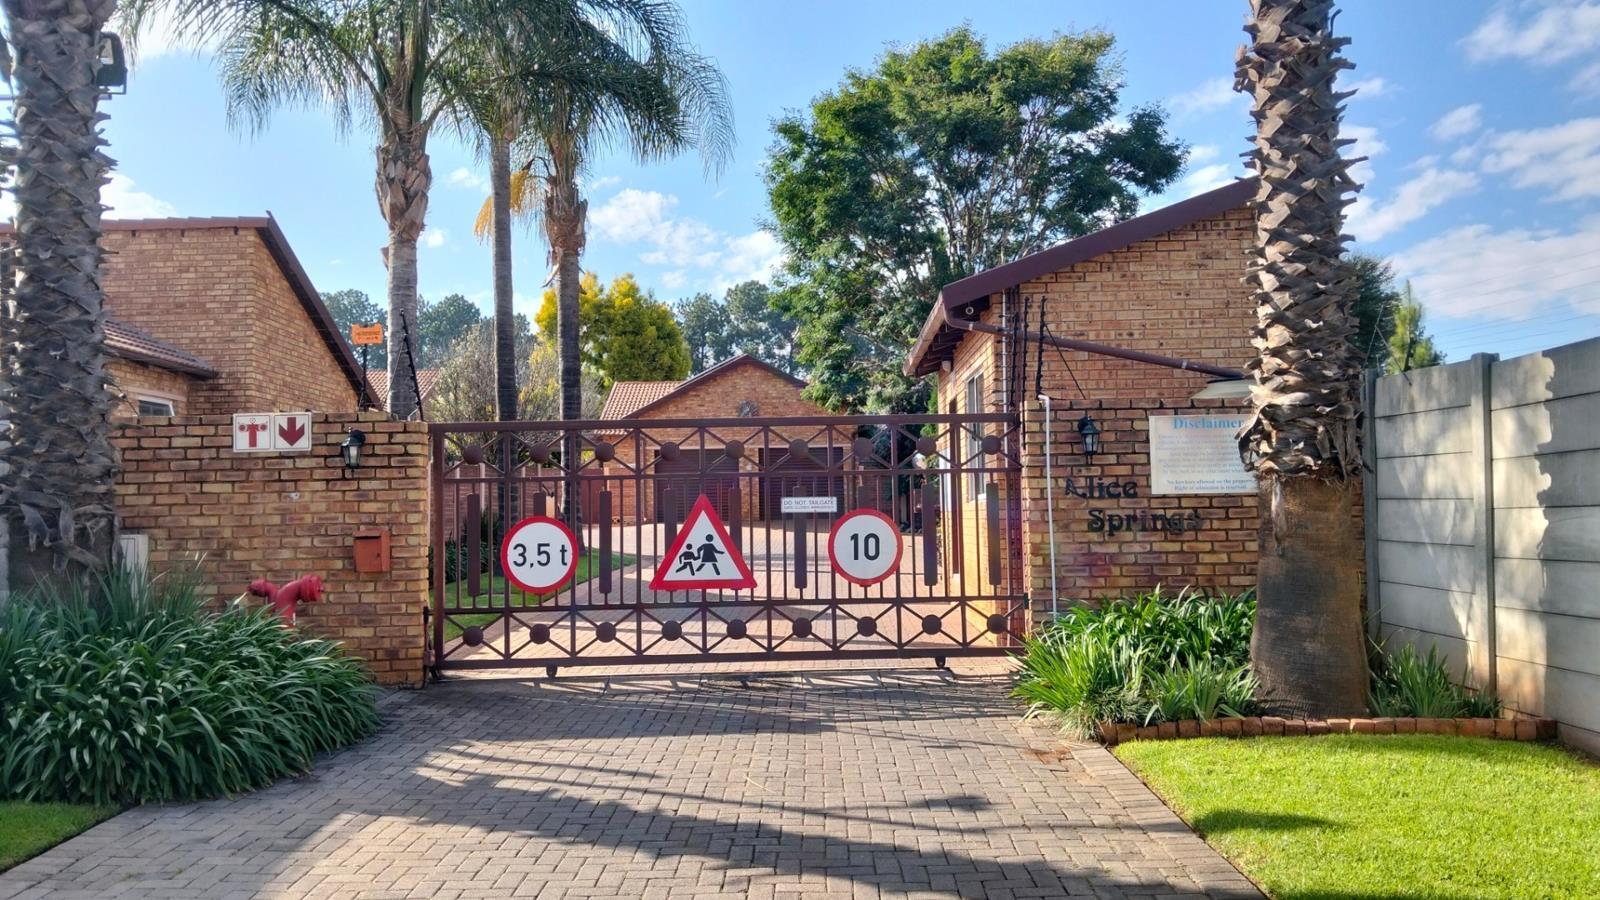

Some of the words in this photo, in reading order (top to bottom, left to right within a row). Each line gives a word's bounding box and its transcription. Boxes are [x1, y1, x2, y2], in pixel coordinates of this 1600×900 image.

[1173, 417, 1244, 429] Disclaimer
[1065, 476, 1138, 499] Alice
[1087, 507, 1204, 536] Springs
[513, 543, 551, 568] 3,5
[559, 544, 568, 566] t
[850, 532, 880, 561] 10
